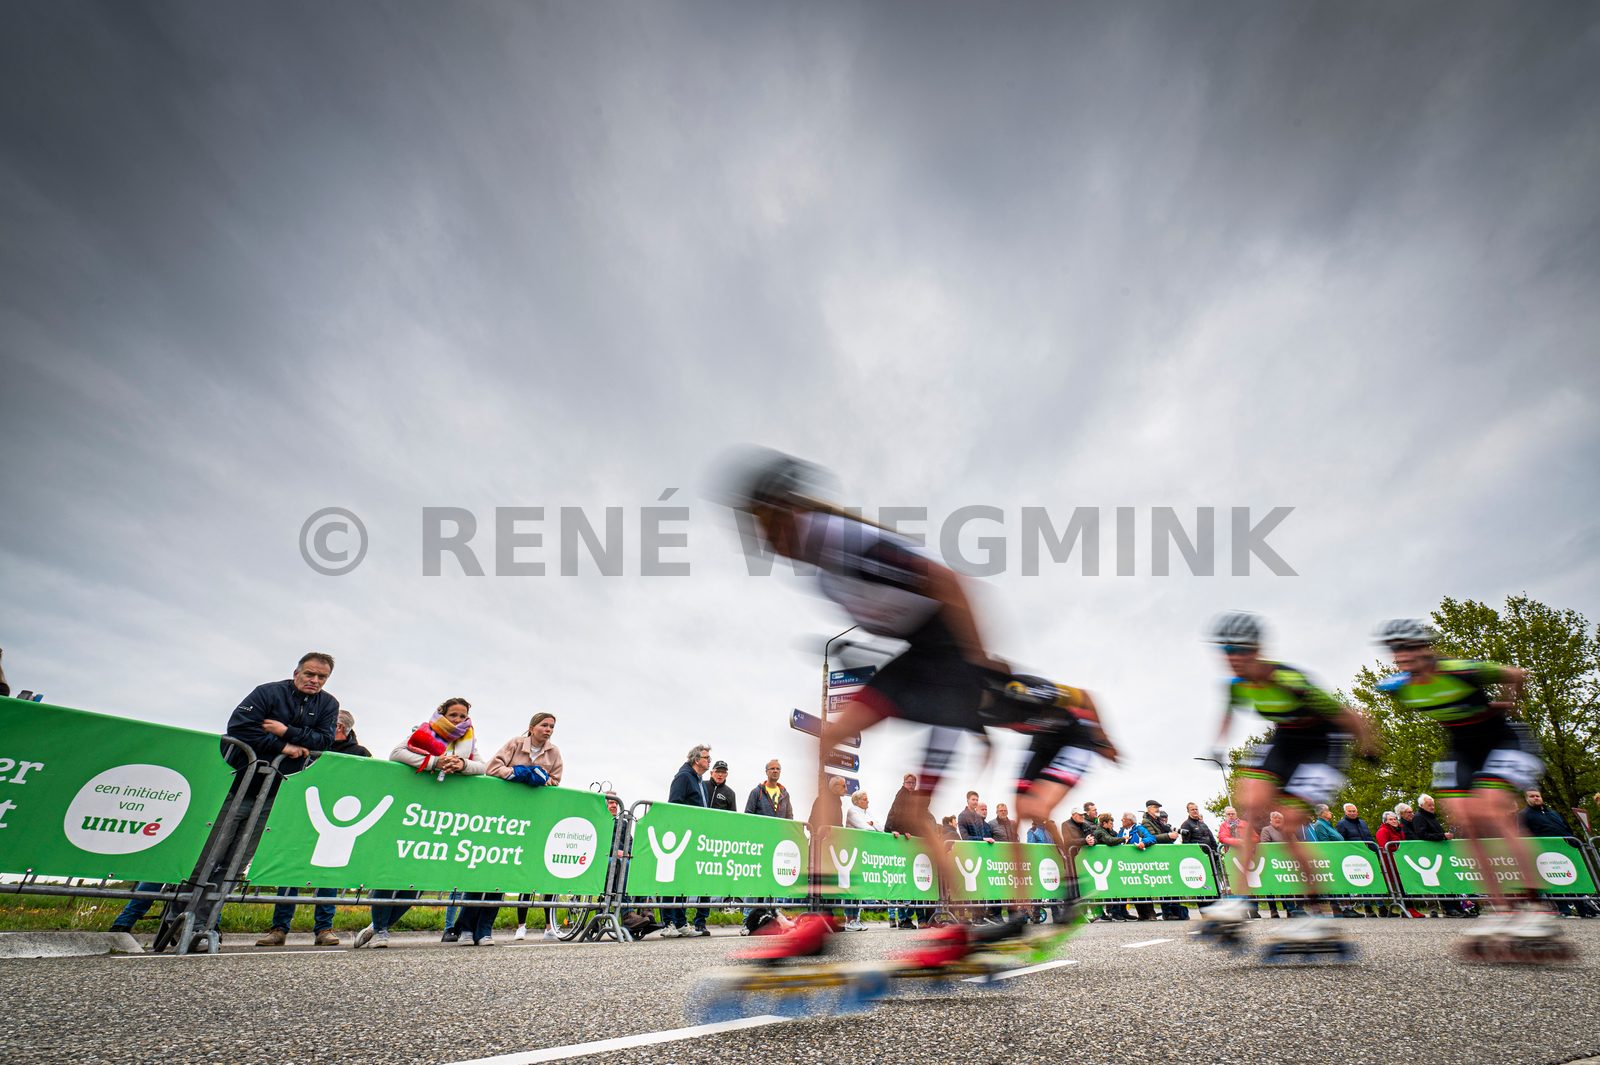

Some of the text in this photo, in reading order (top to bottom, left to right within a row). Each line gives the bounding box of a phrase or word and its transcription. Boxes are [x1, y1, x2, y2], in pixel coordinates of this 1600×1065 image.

[94, 784, 183, 802] een initiatief
[119, 801, 145, 812] van
[81, 816, 163, 837] univé
[402, 803, 531, 836] Supporter
[566, 832, 593, 842] initiatief
[697, 834, 764, 858] Supporter
[396, 839, 524, 869] van Sport
[552, 852, 587, 865] univé
[861, 850, 907, 869] Supporter
[986, 859, 1031, 873] Suppoer
[1117, 860, 1170, 874] Supporter
[1270, 858, 1331, 871] Supprter
[1449, 856, 1520, 869] Suprte
[695, 859, 762, 881] van Sport
[862, 870, 907, 887] van Sport
[988, 874, 1034, 889] van Sport
[1120, 873, 1174, 887] van Sport
[1274, 872, 1336, 885] van Sport
[1454, 871, 1526, 884] van por
